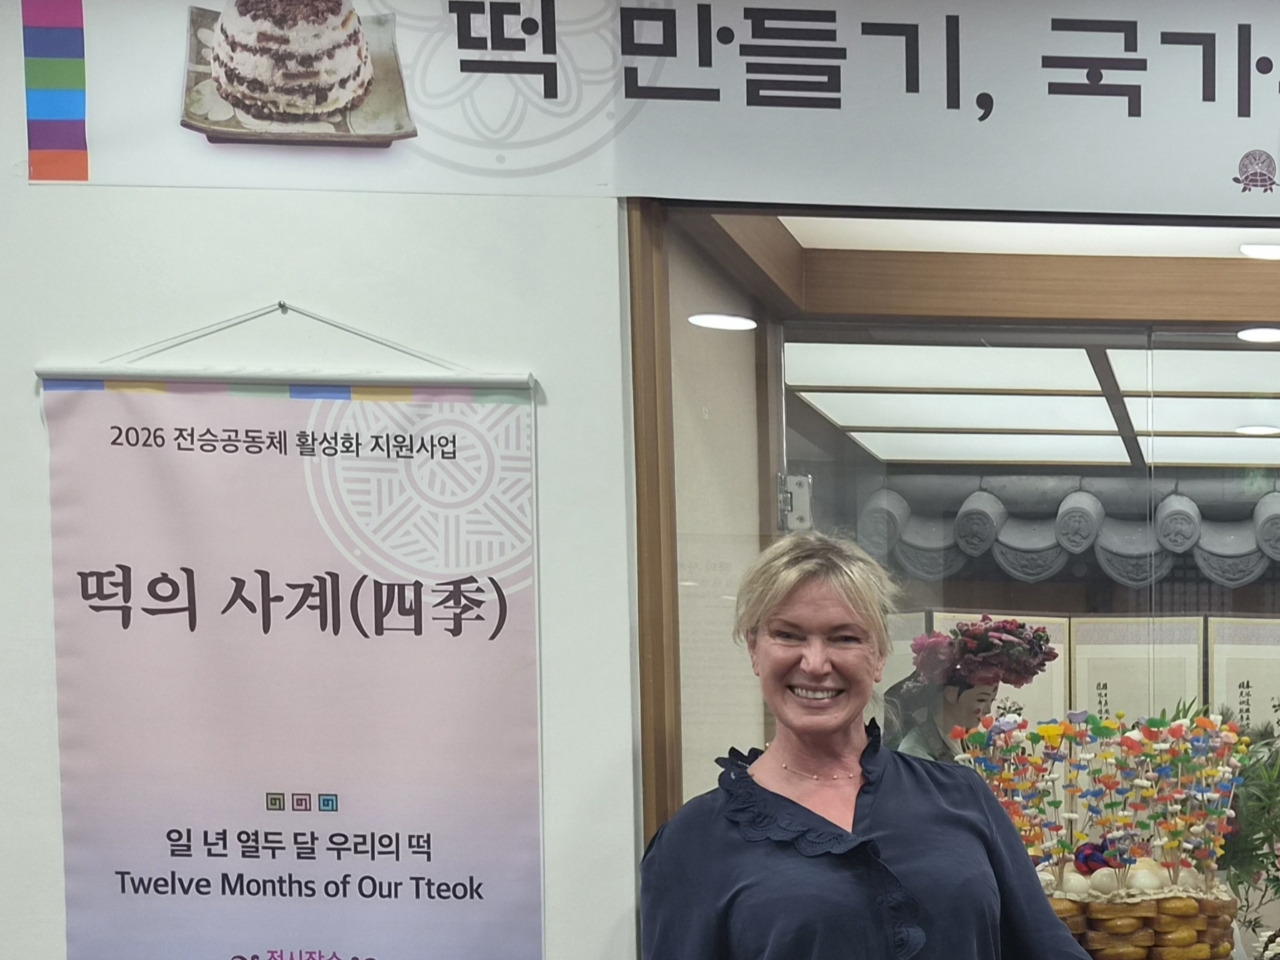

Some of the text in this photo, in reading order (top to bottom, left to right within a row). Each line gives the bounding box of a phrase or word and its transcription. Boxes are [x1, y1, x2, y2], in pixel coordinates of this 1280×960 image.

[448, 0, 558, 99] 떡
[620, 3, 993, 121] 만들기,
[111, 426, 456, 459] 2026 전승공동체 활성화 지원사업
[77, 564, 507, 640] 떡의 사계(四季)
[166, 829, 431, 862] 일 년 열두 달 우리의 떡
[115, 871, 483, 899] Twelve Months of Our Tteok
